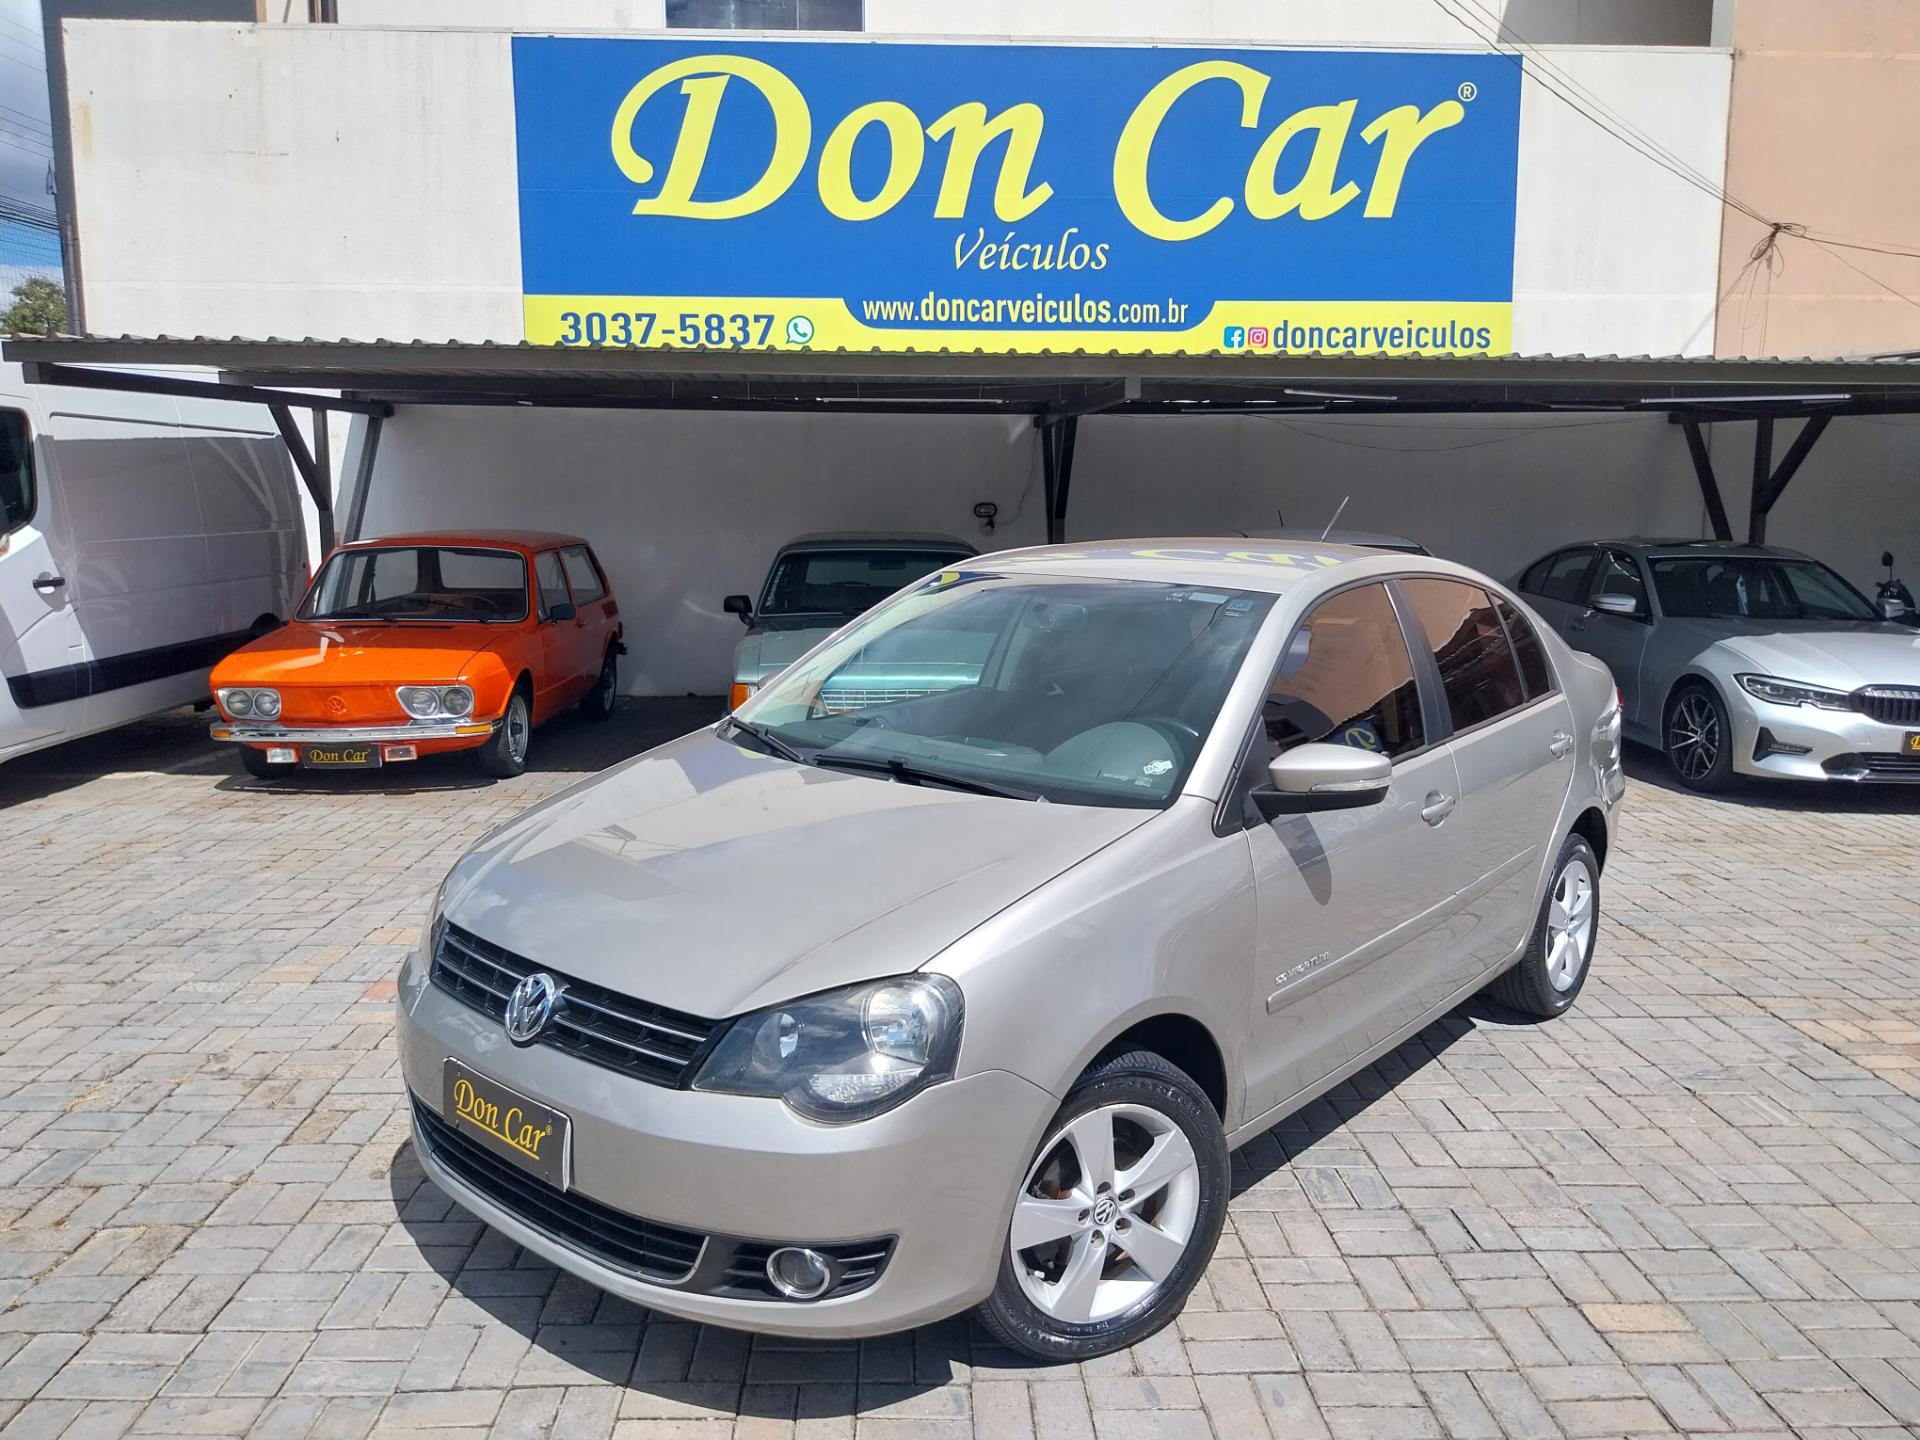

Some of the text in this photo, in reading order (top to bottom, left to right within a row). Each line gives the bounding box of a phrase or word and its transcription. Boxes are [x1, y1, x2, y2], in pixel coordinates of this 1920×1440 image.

[611, 54, 1054, 222] Don
[953, 227, 1110, 270] Veículos
[862, 291, 1189, 324] www.doncarveiculos.com.br
[560, 311, 775, 346] 3037-5837
[1273, 318, 1491, 349] doncarveiculos
[309, 749, 339, 761] Don
[454, 1079, 498, 1129] Don
